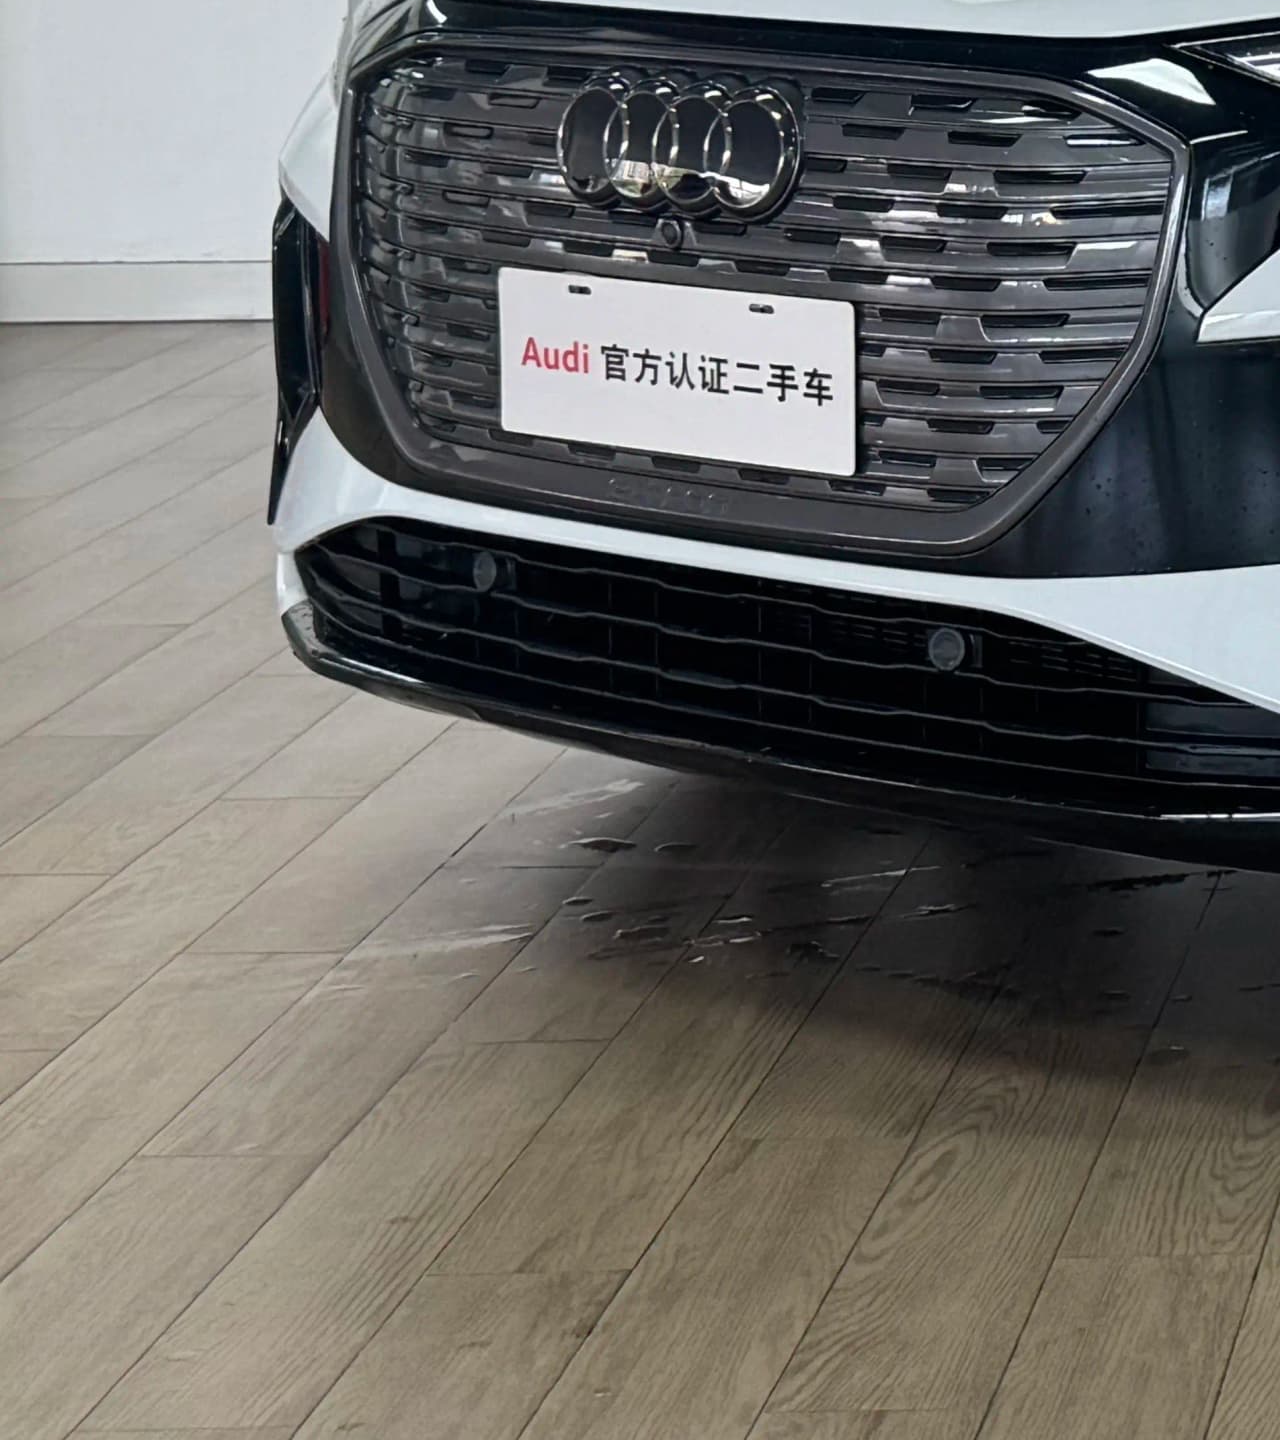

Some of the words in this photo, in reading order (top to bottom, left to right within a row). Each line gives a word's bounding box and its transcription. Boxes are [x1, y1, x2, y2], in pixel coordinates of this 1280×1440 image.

[521, 337, 590, 374] Audi
[600, 344, 834, 407] 官方认证二手车
